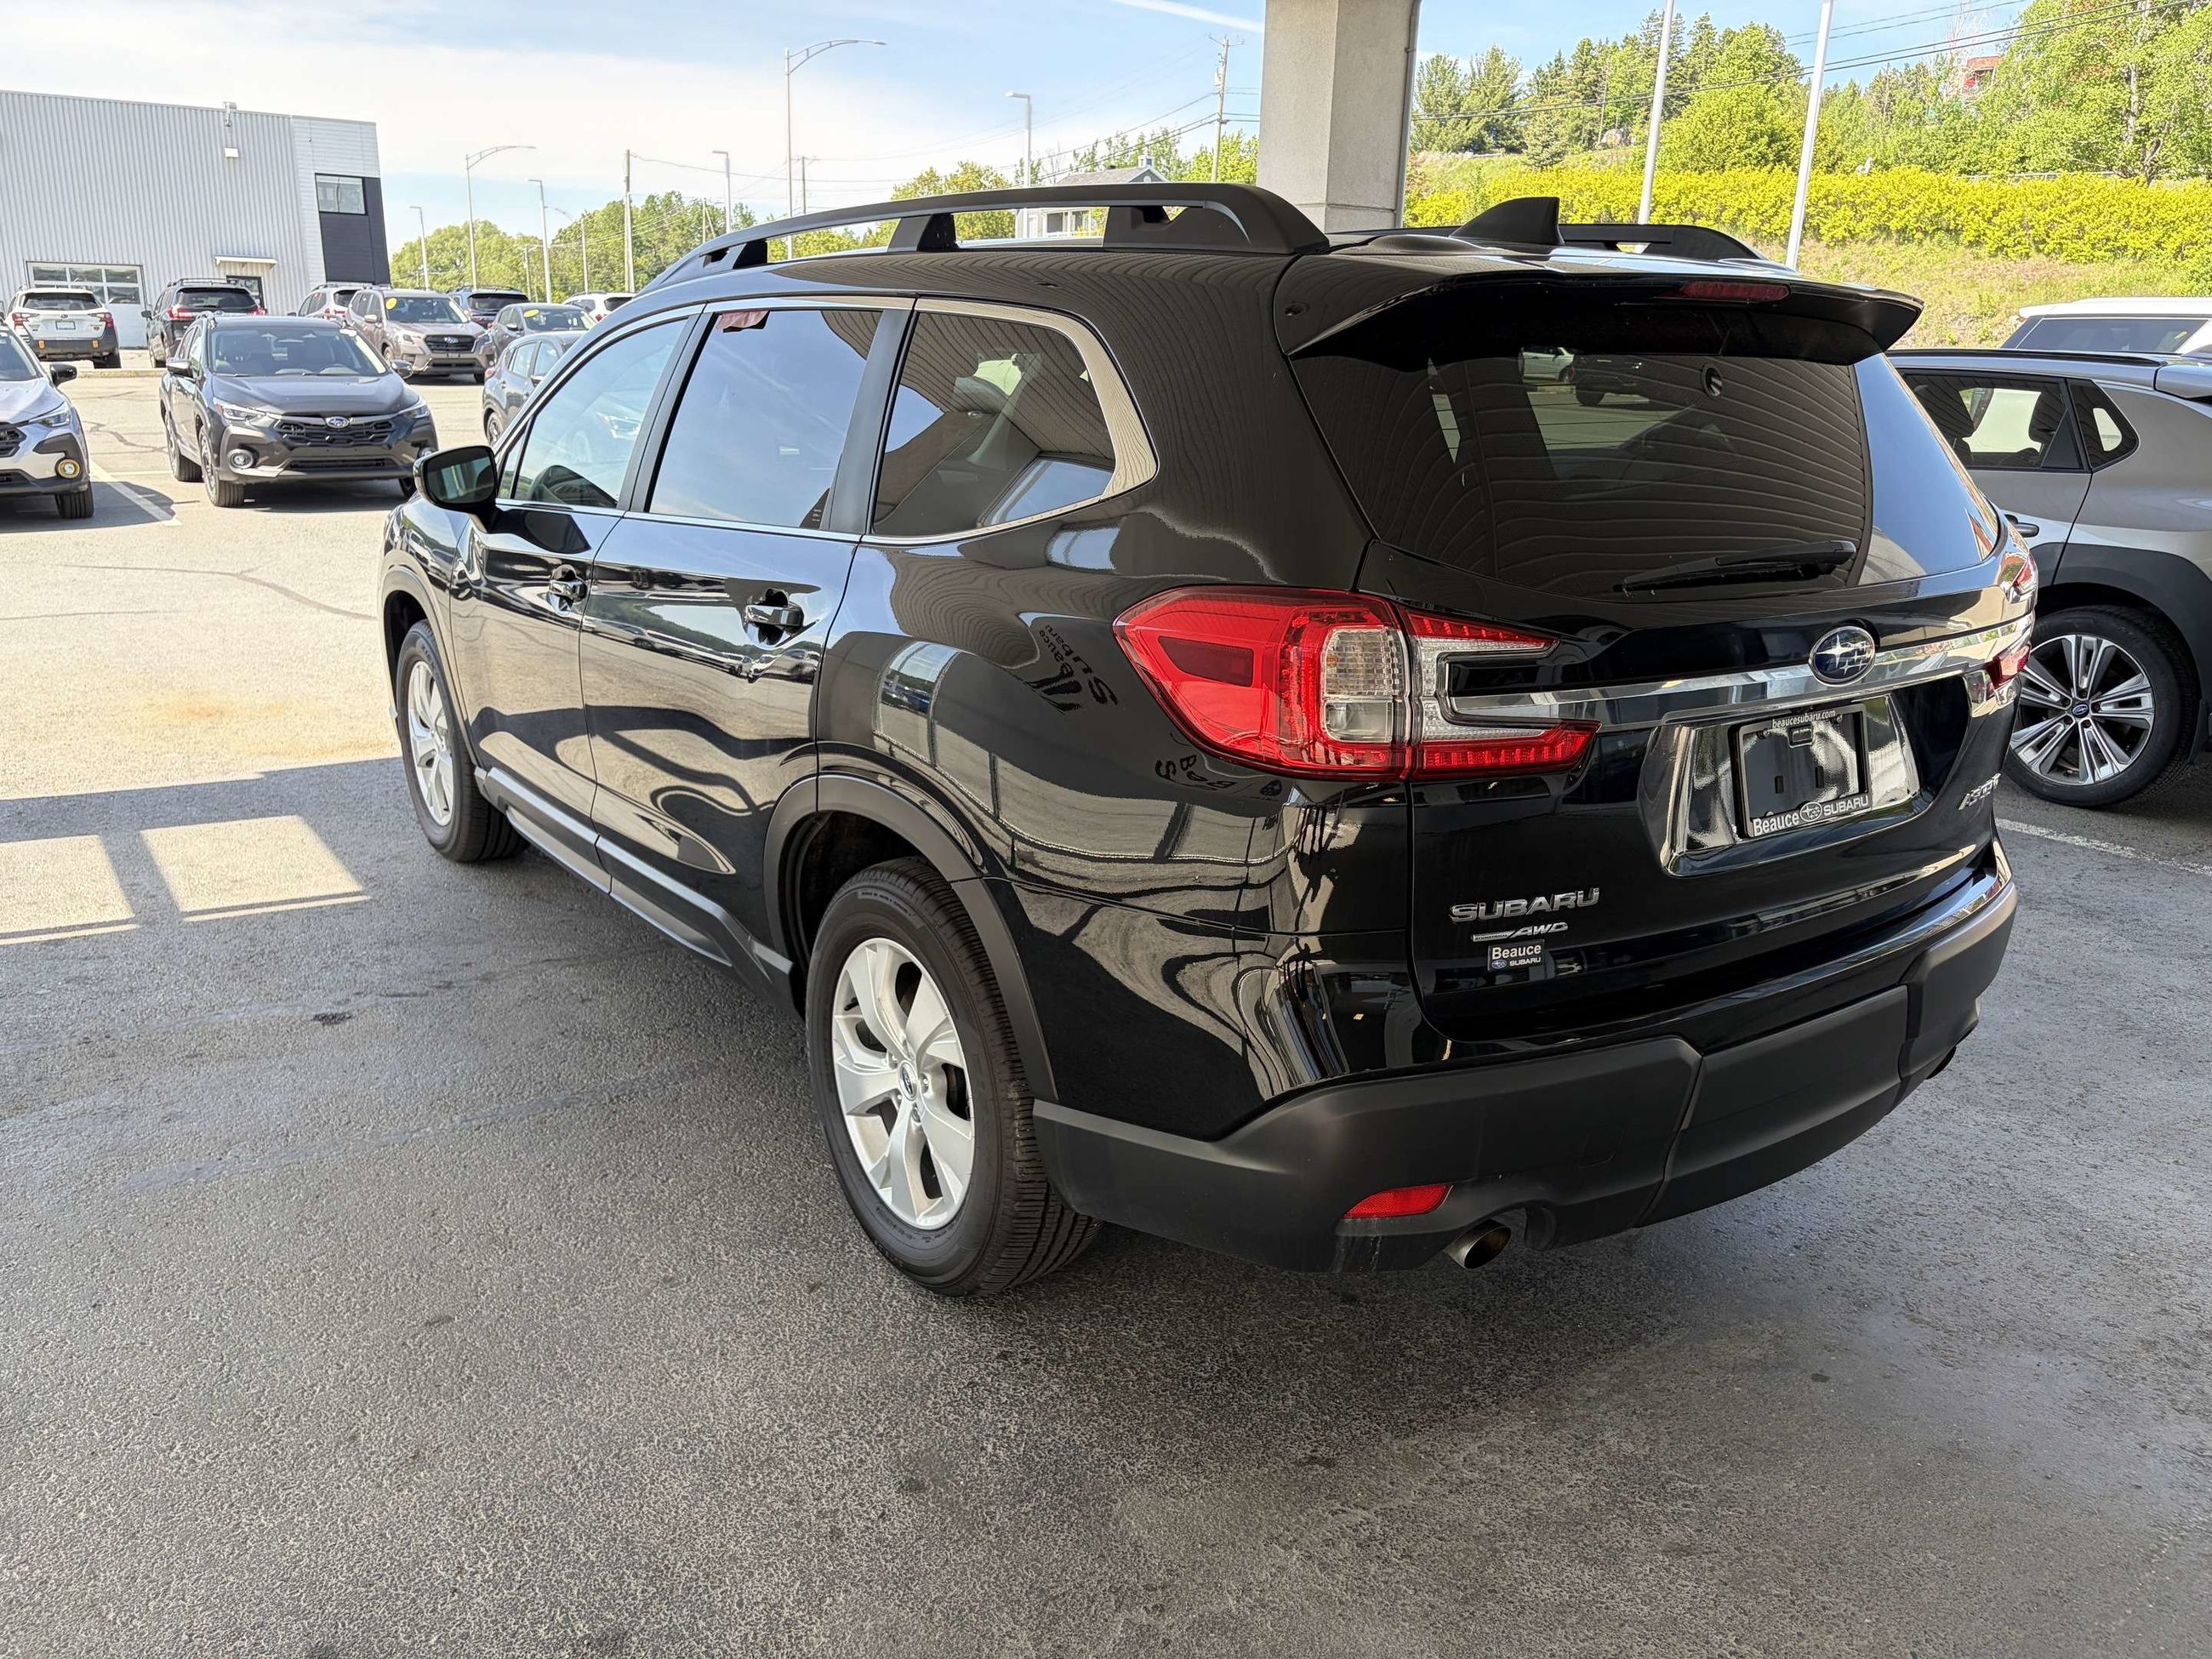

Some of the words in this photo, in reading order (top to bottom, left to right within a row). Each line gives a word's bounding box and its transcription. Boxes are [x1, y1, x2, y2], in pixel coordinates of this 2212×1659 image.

[1771, 710, 1836, 729] beaucesubaru.com
[1753, 811, 1800, 837] Beauce
[1823, 795, 1869, 817] SUBARU
[1448, 887, 1600, 923] SUBARU
[1509, 921, 1569, 938] AWD
[1491, 944, 1542, 961] Beauce
[1509, 957, 1542, 966] SUBARU
